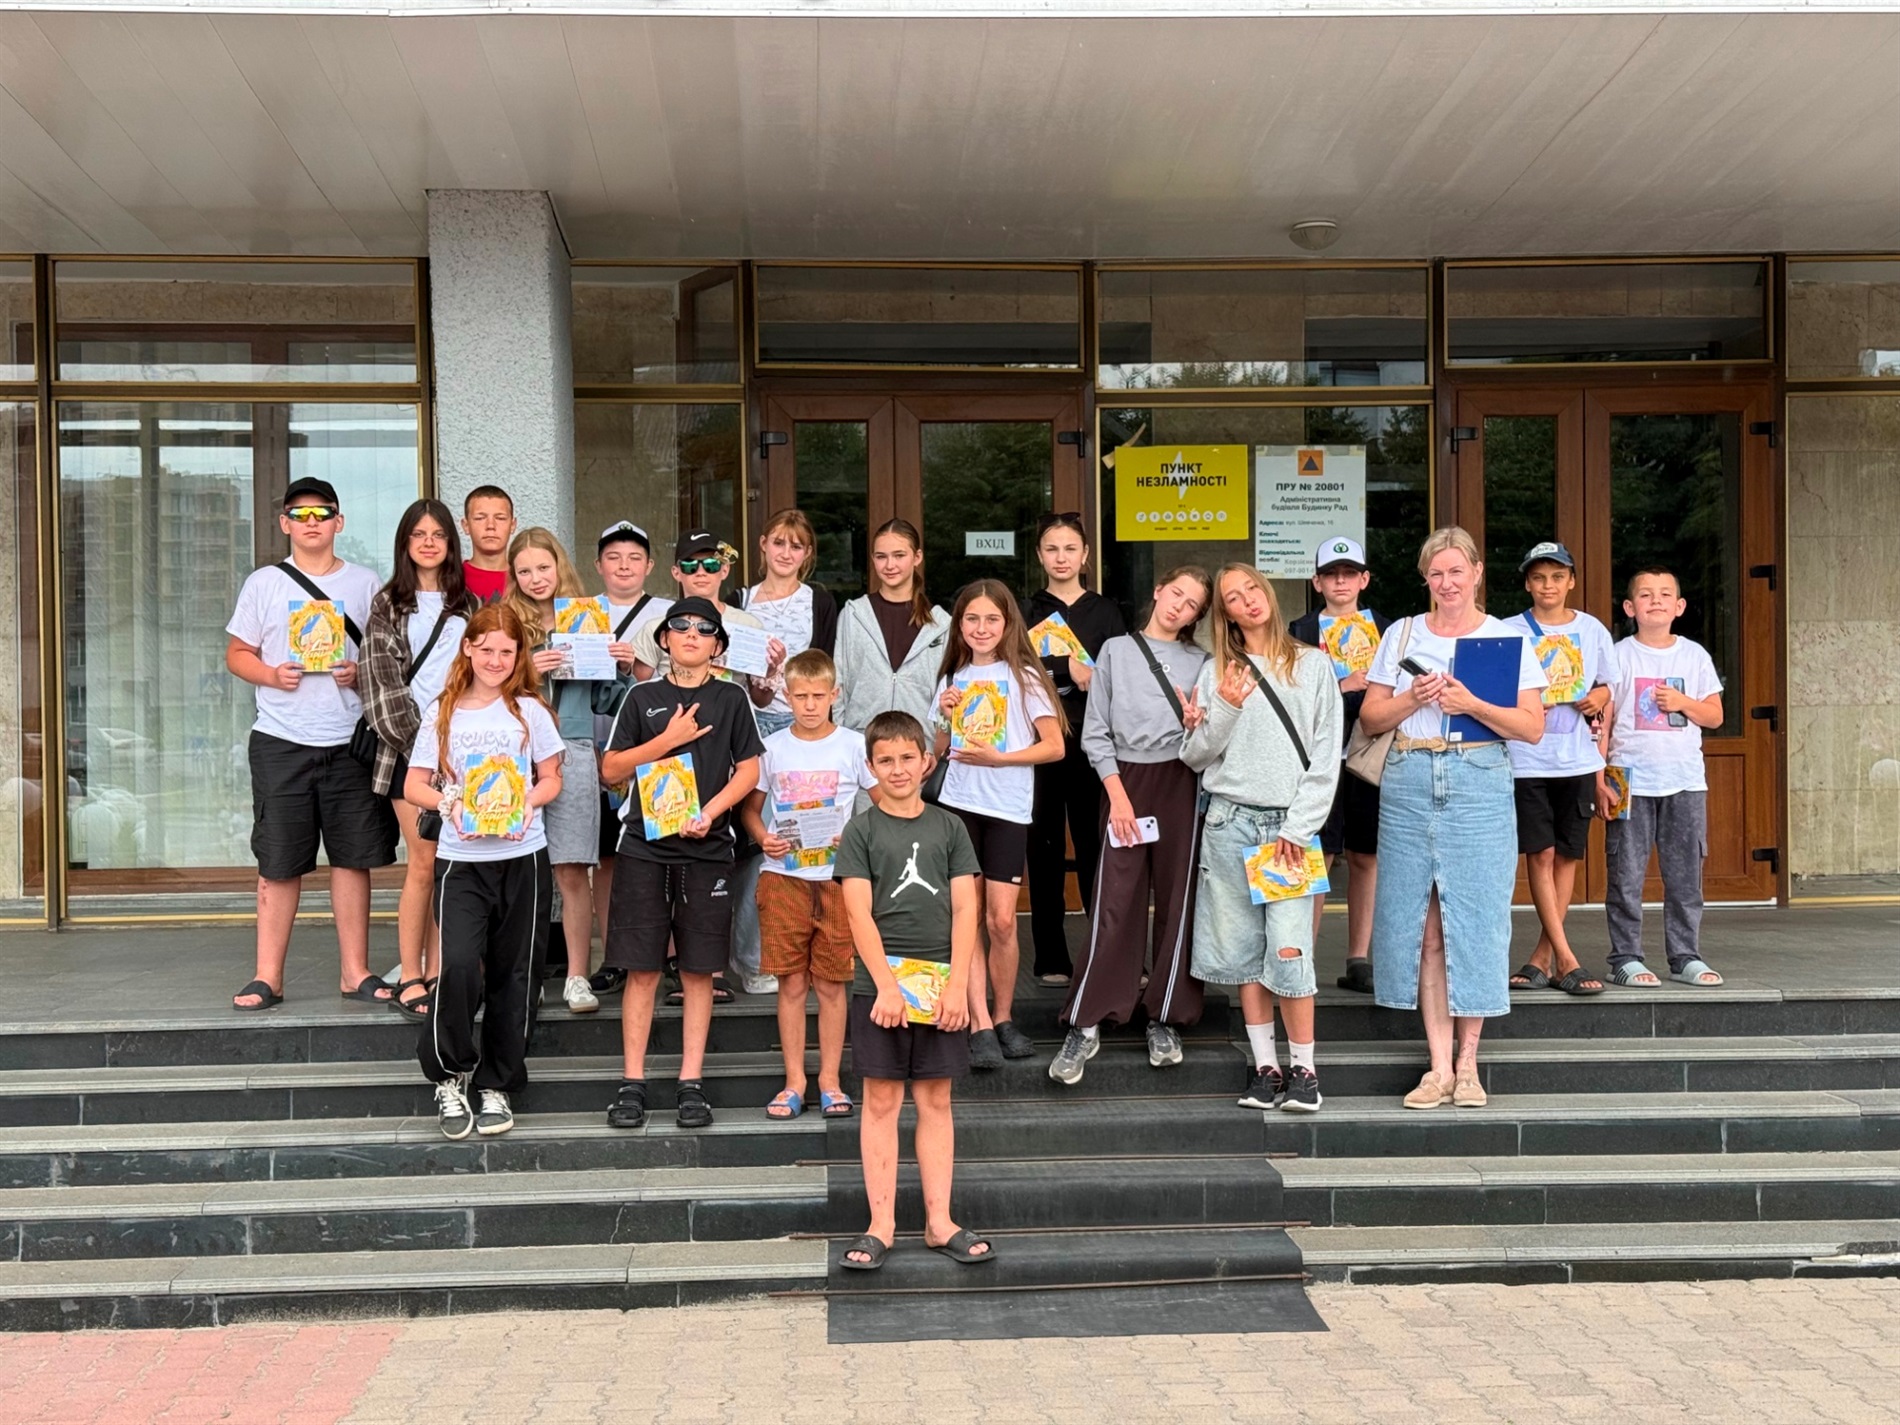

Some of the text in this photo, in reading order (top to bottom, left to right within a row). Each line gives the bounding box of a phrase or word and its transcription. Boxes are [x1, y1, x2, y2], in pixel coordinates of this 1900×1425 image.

[1160, 462, 1203, 474] ПУНКТ
[1136, 475, 1227, 487] НЕЗЛАМНОСТІ
[1275, 482, 1345, 491] ПРУ № 20801
[1279, 495, 1341, 504] Адміністративна
[1271, 503, 1349, 511] будівля Будинку Рад
[976, 538, 1005, 550] ВХІД
